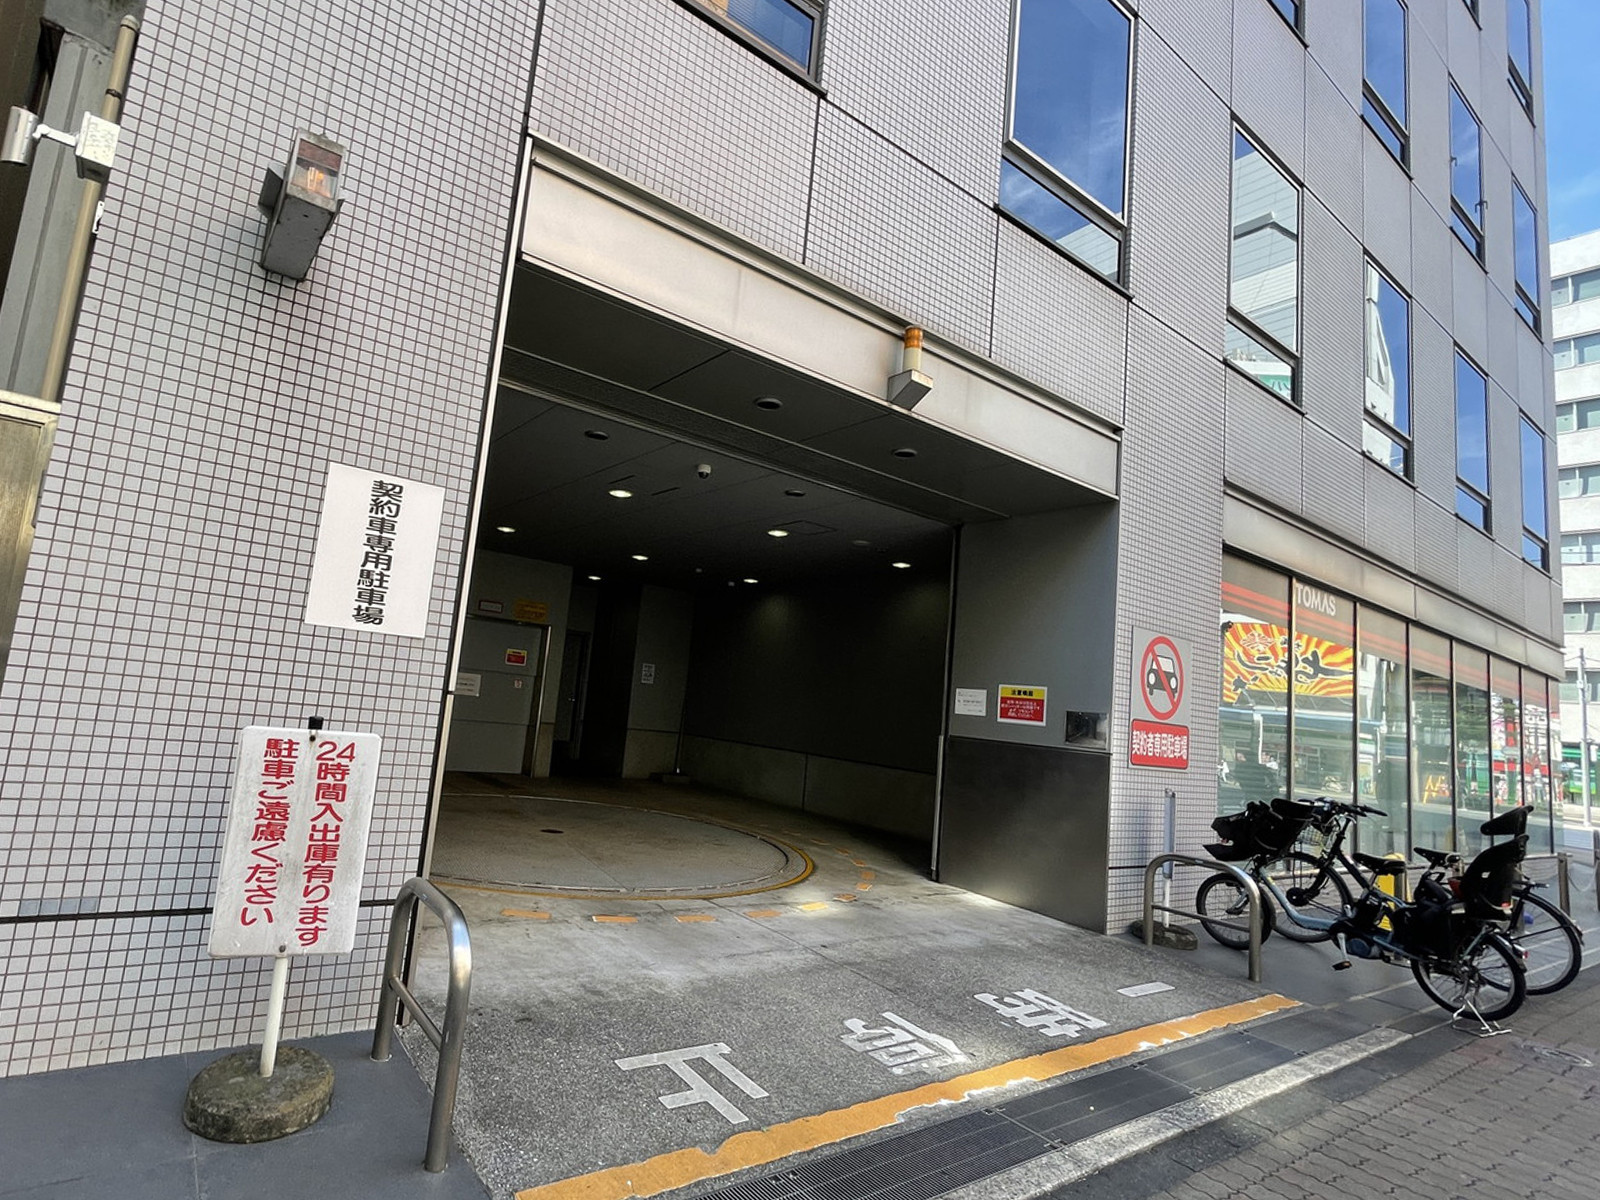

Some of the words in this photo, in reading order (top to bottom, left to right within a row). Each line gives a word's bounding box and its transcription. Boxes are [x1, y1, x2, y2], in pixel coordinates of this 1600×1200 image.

[352, 480, 404, 625] 契約車専用駐車場
[1295, 584, 1337, 616] TOMAS
[1132, 730, 1188, 760] 契約者専用駐車場
[240, 738, 300, 926] 駐車ご遠慮ください
[295, 741, 356, 947] 24時間入出庫有ります
